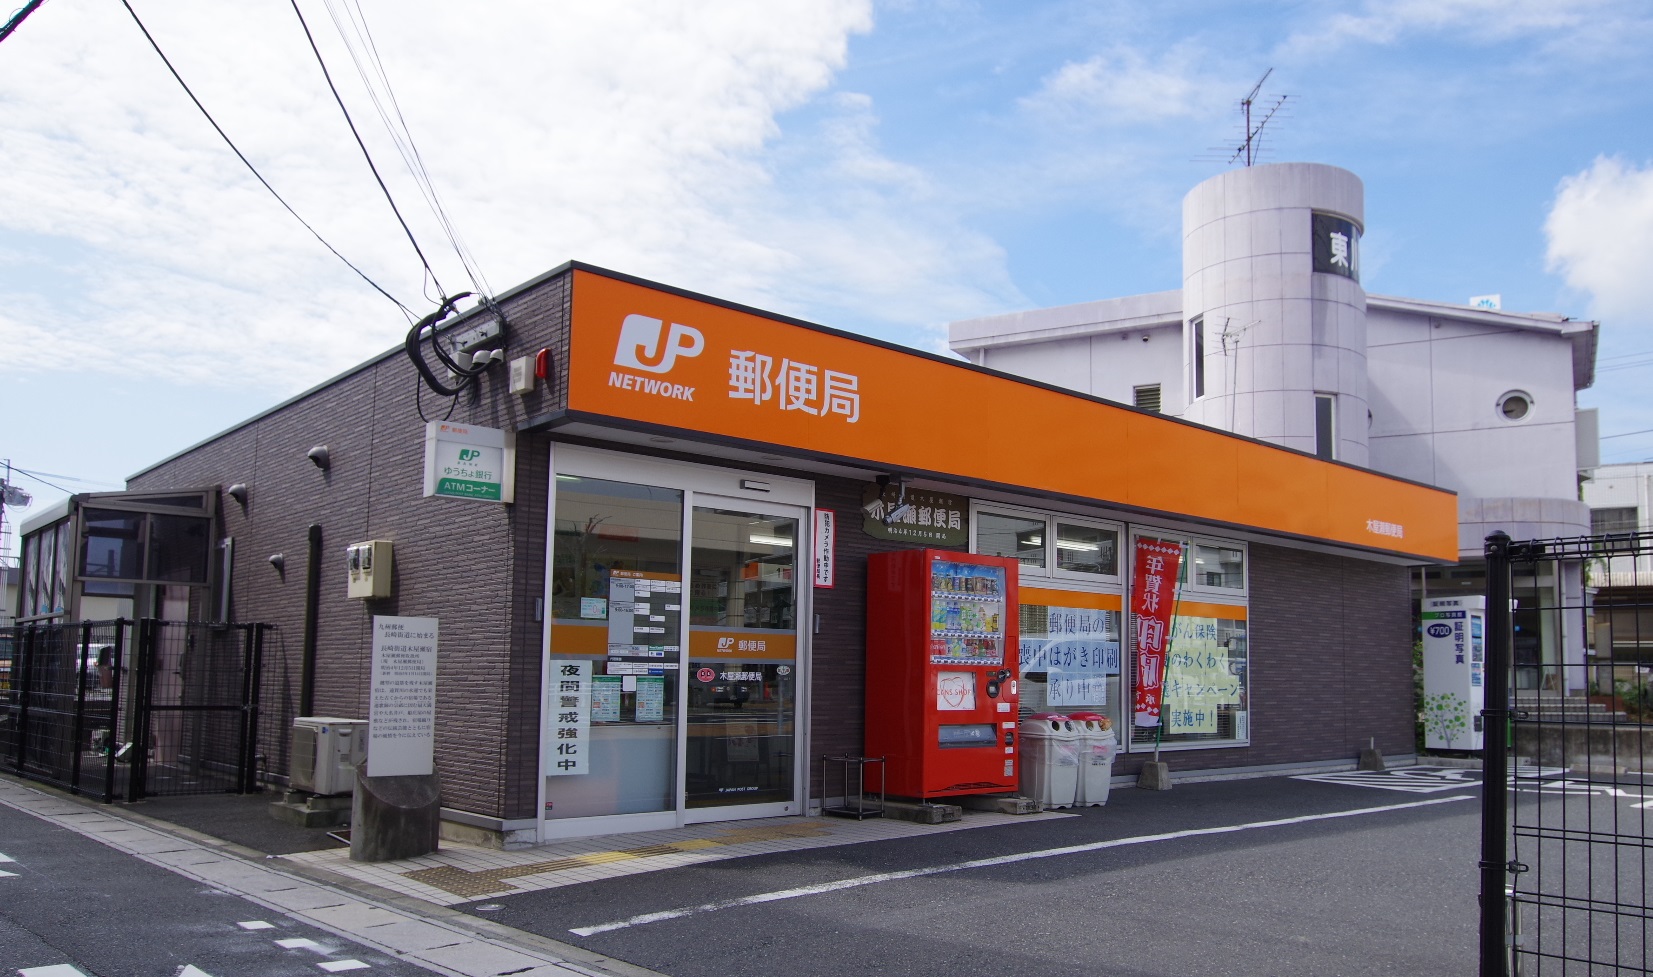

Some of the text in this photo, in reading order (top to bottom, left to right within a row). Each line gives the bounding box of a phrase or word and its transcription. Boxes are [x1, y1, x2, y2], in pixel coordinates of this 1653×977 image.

[613, 314, 704, 374] JP
[608, 371, 696, 402] NETWORK
[728, 350, 860, 423] 郵便局
[459, 448, 480, 461] JP
[444, 467, 492, 480] ゆうちょ銀行
[444, 482, 495, 494] ATMコーナー
[1049, 613, 1104, 636] 郵便局の
[1172, 623, 1216, 640] がん保険
[1430, 626, 1450, 636] ¥700
[717, 637, 734, 649] JP
[738, 639, 766, 652] 郵便局
[1455, 622, 1464, 664] 証明写真
[557, 664, 581, 771] 夜間警戒強化中
